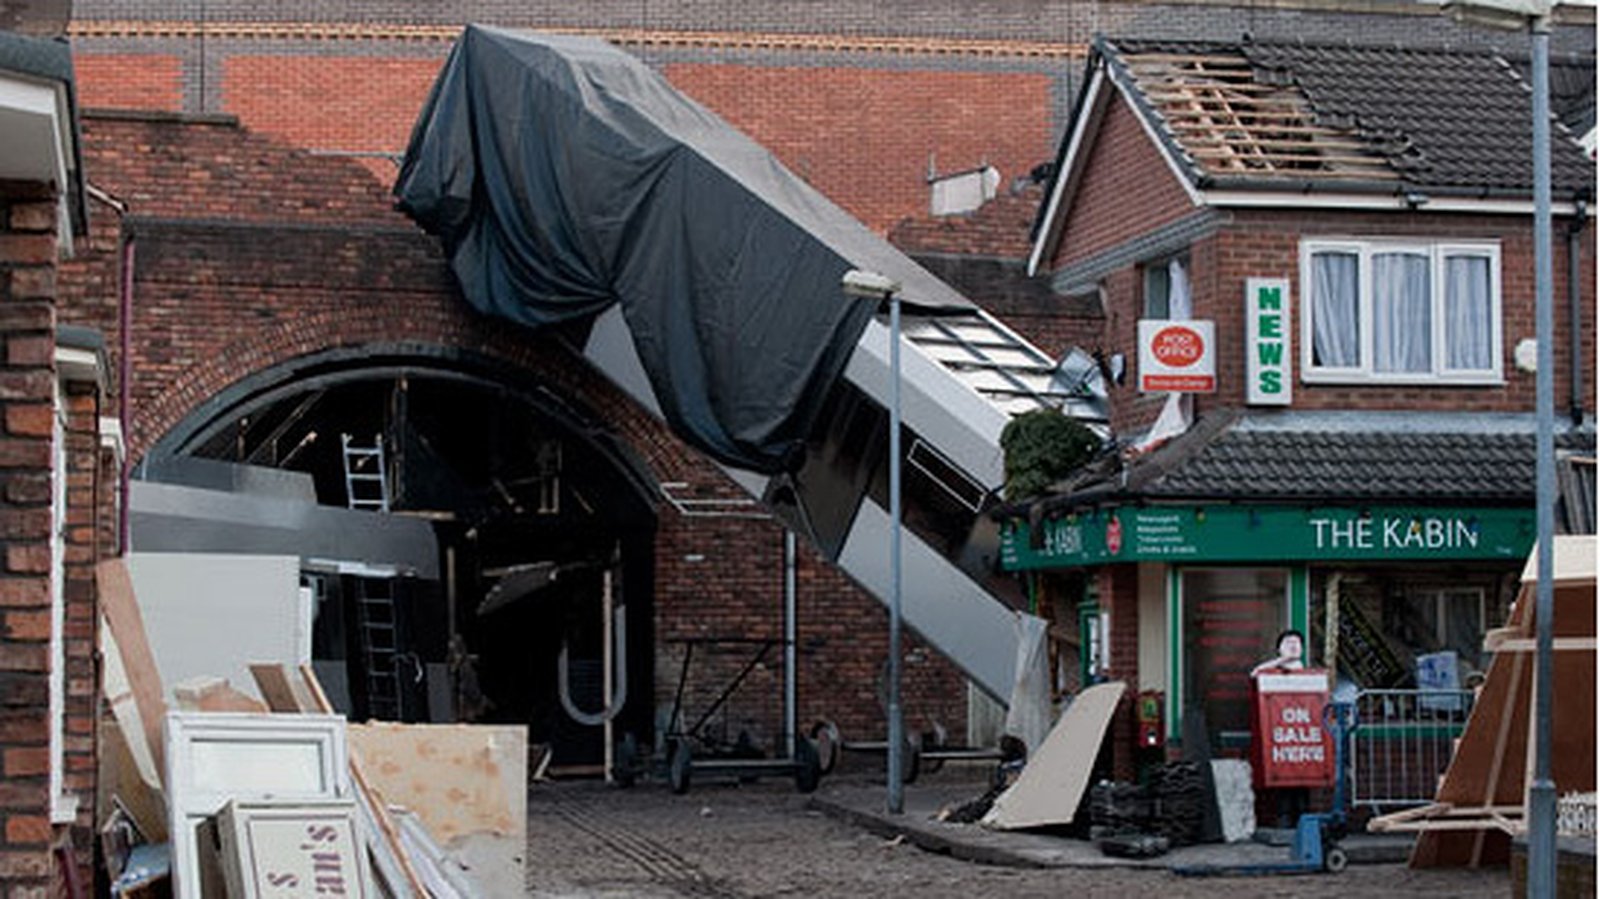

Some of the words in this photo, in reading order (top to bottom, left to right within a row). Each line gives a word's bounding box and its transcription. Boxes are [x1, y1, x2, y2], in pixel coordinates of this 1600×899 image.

[1162, 333, 1194, 347] POST
[1258, 287, 1282, 393] NEWS
[1157, 346, 1197, 358] OFFICE
[1309, 518, 1374, 548] THE
[1383, 518, 1479, 549] KABIN
[1281, 707, 1311, 723] ON
[1273, 726, 1322, 743] SALE
[1272, 744, 1325, 762] HERE
